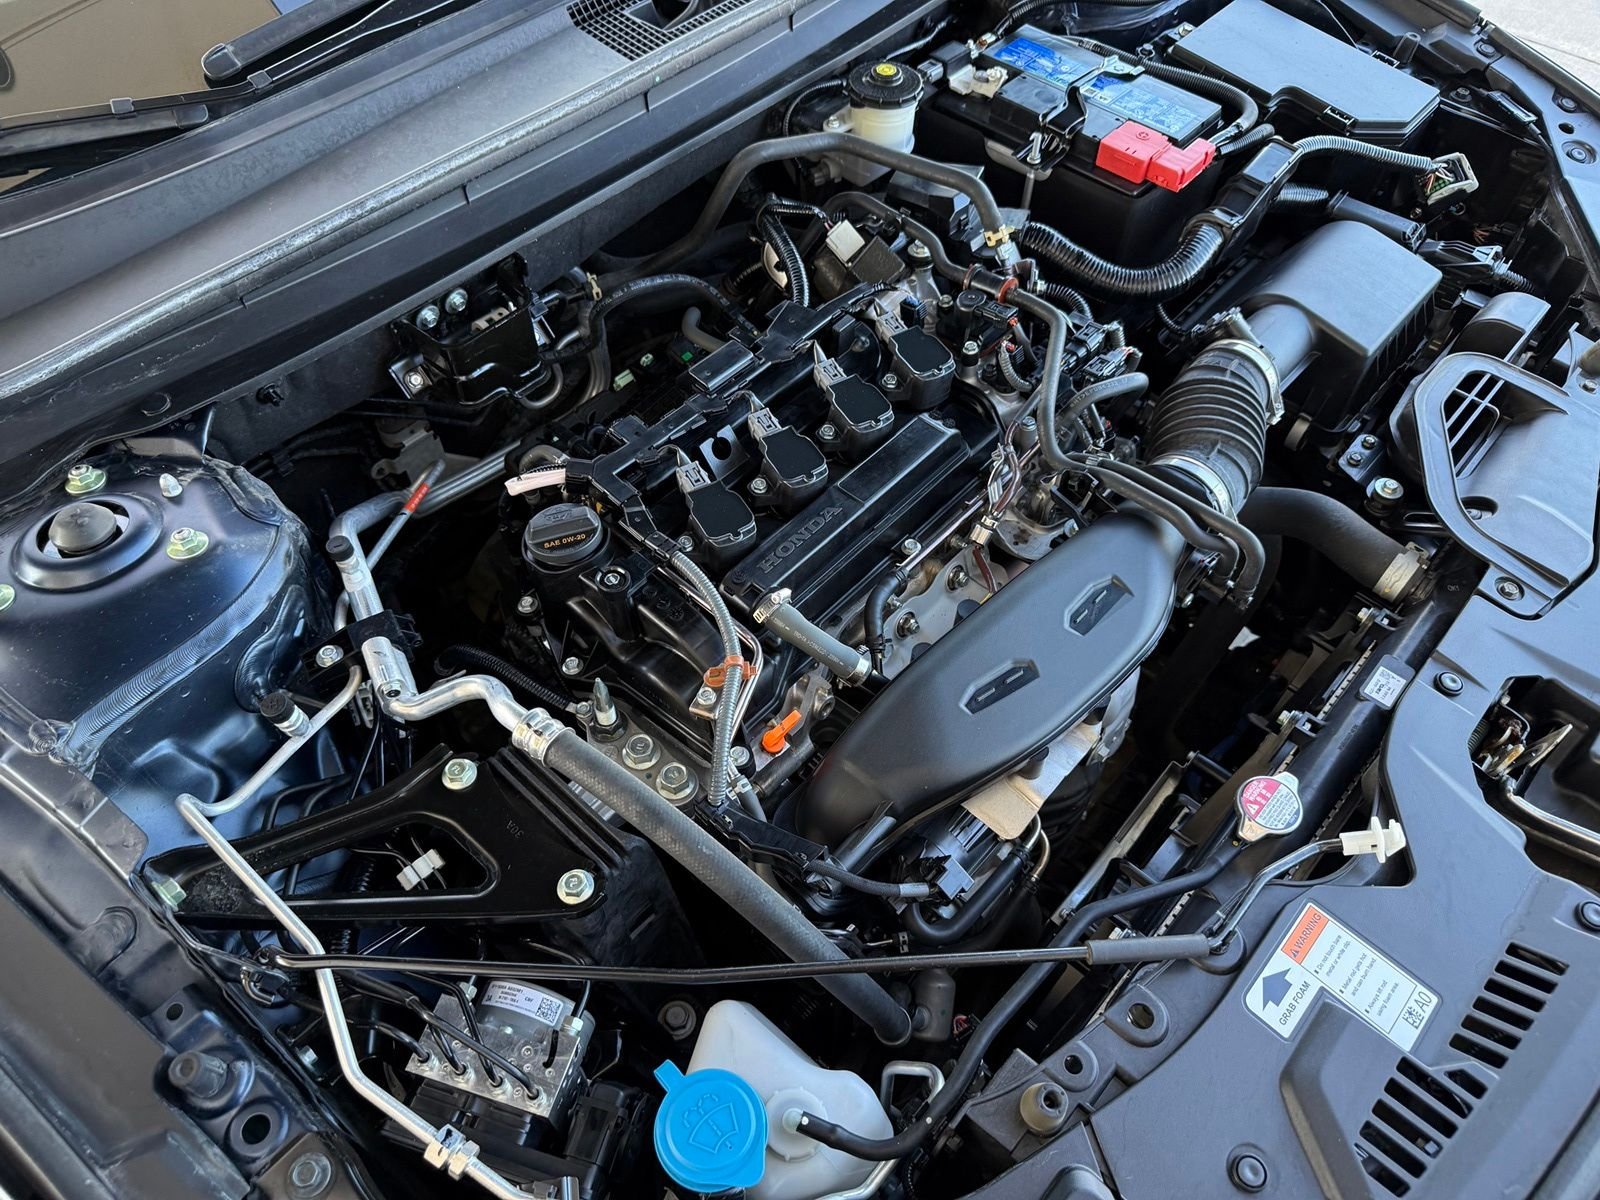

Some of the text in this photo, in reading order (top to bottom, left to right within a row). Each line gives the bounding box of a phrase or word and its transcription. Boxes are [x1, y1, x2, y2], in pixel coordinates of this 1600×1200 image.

[543, 532, 587, 550] SAE 0W-20
[756, 505, 844, 573] HONDA
[1295, 912, 1322, 950] WARNING
[1279, 981, 1311, 1026] GRAB FOAM
[1414, 991, 1432, 1014] A0
